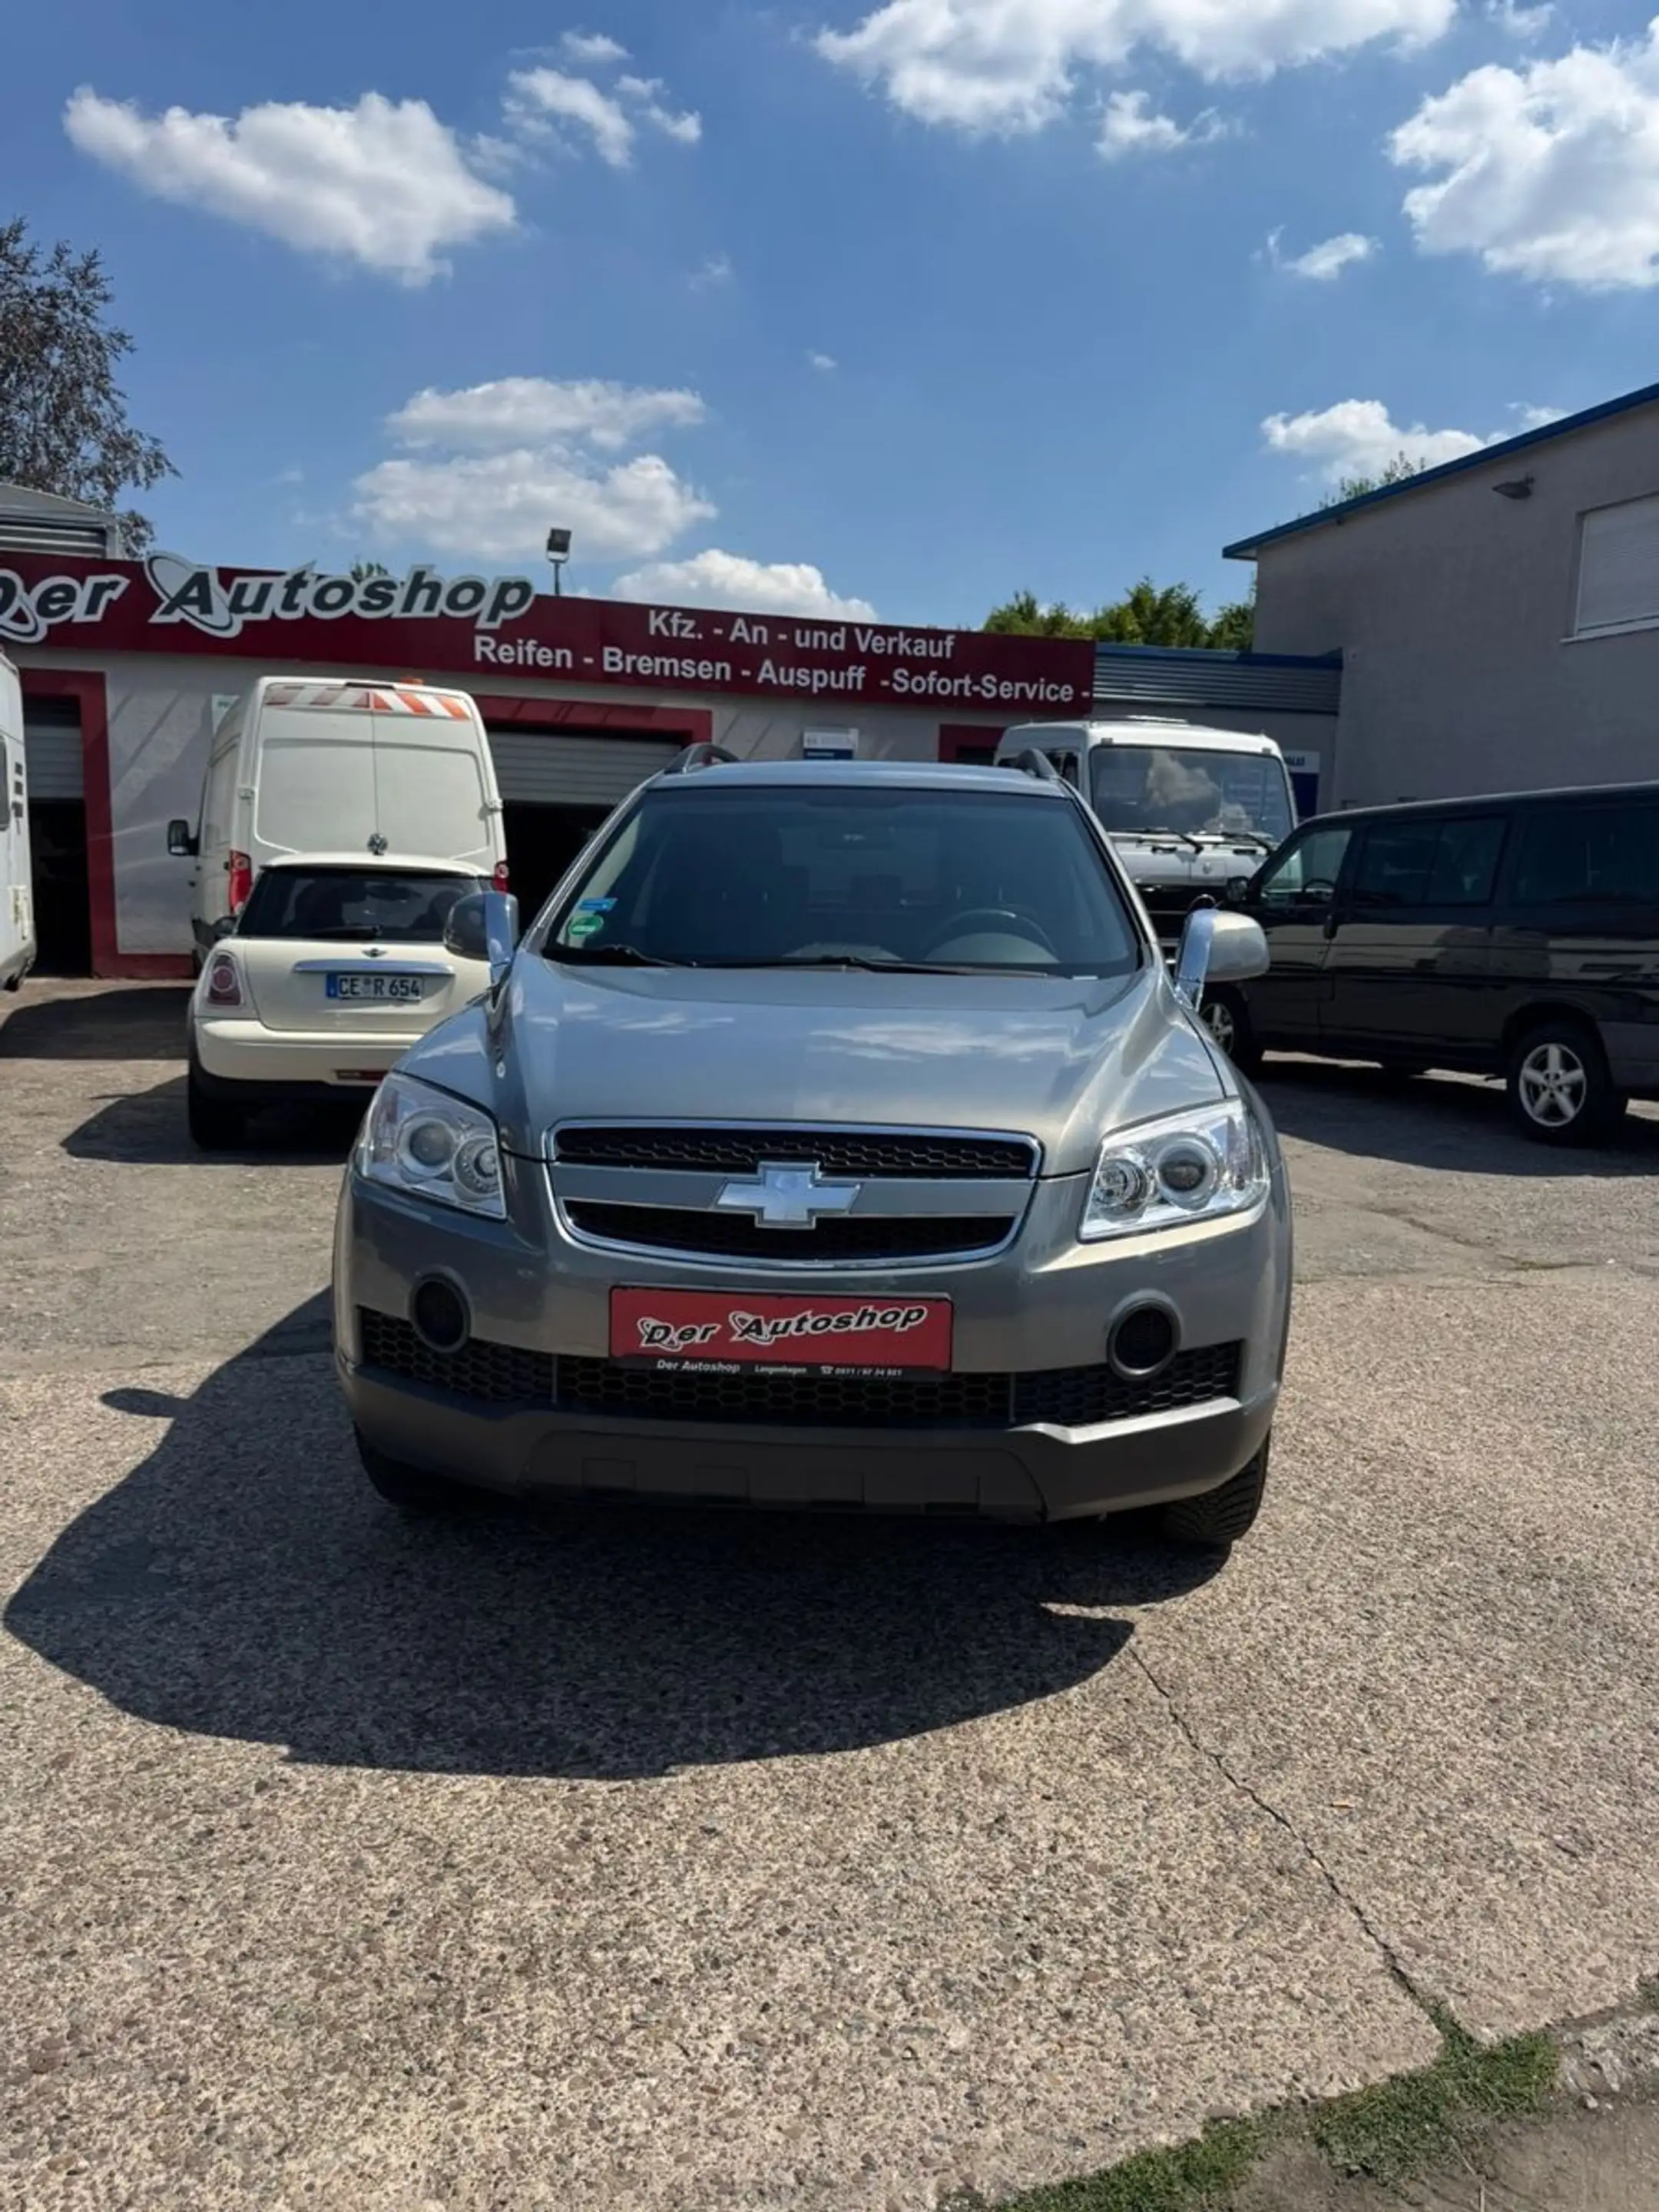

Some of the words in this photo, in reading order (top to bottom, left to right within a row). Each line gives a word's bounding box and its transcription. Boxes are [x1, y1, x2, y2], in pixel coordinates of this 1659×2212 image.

[0, 568, 130, 642] er
[144, 550, 535, 638] Autoshop
[649, 610, 703, 640] Kfz.
[729, 618, 768, 644] An
[795, 627, 845, 652] und
[855, 628, 955, 659] Verkauf
[474, 636, 572, 668] Reifen
[603, 647, 731, 681] Bremsen
[757, 660, 866, 694] Auspuff
[339, 977, 360, 995] CE
[374, 978, 385, 996] R
[389, 979, 420, 997] 654
[637, 1317, 721, 1352] Der
[729, 1306, 928, 1345] Autoshop
[657, 1359, 678, 1370] Der
[681, 1360, 740, 1373] Autoshop
